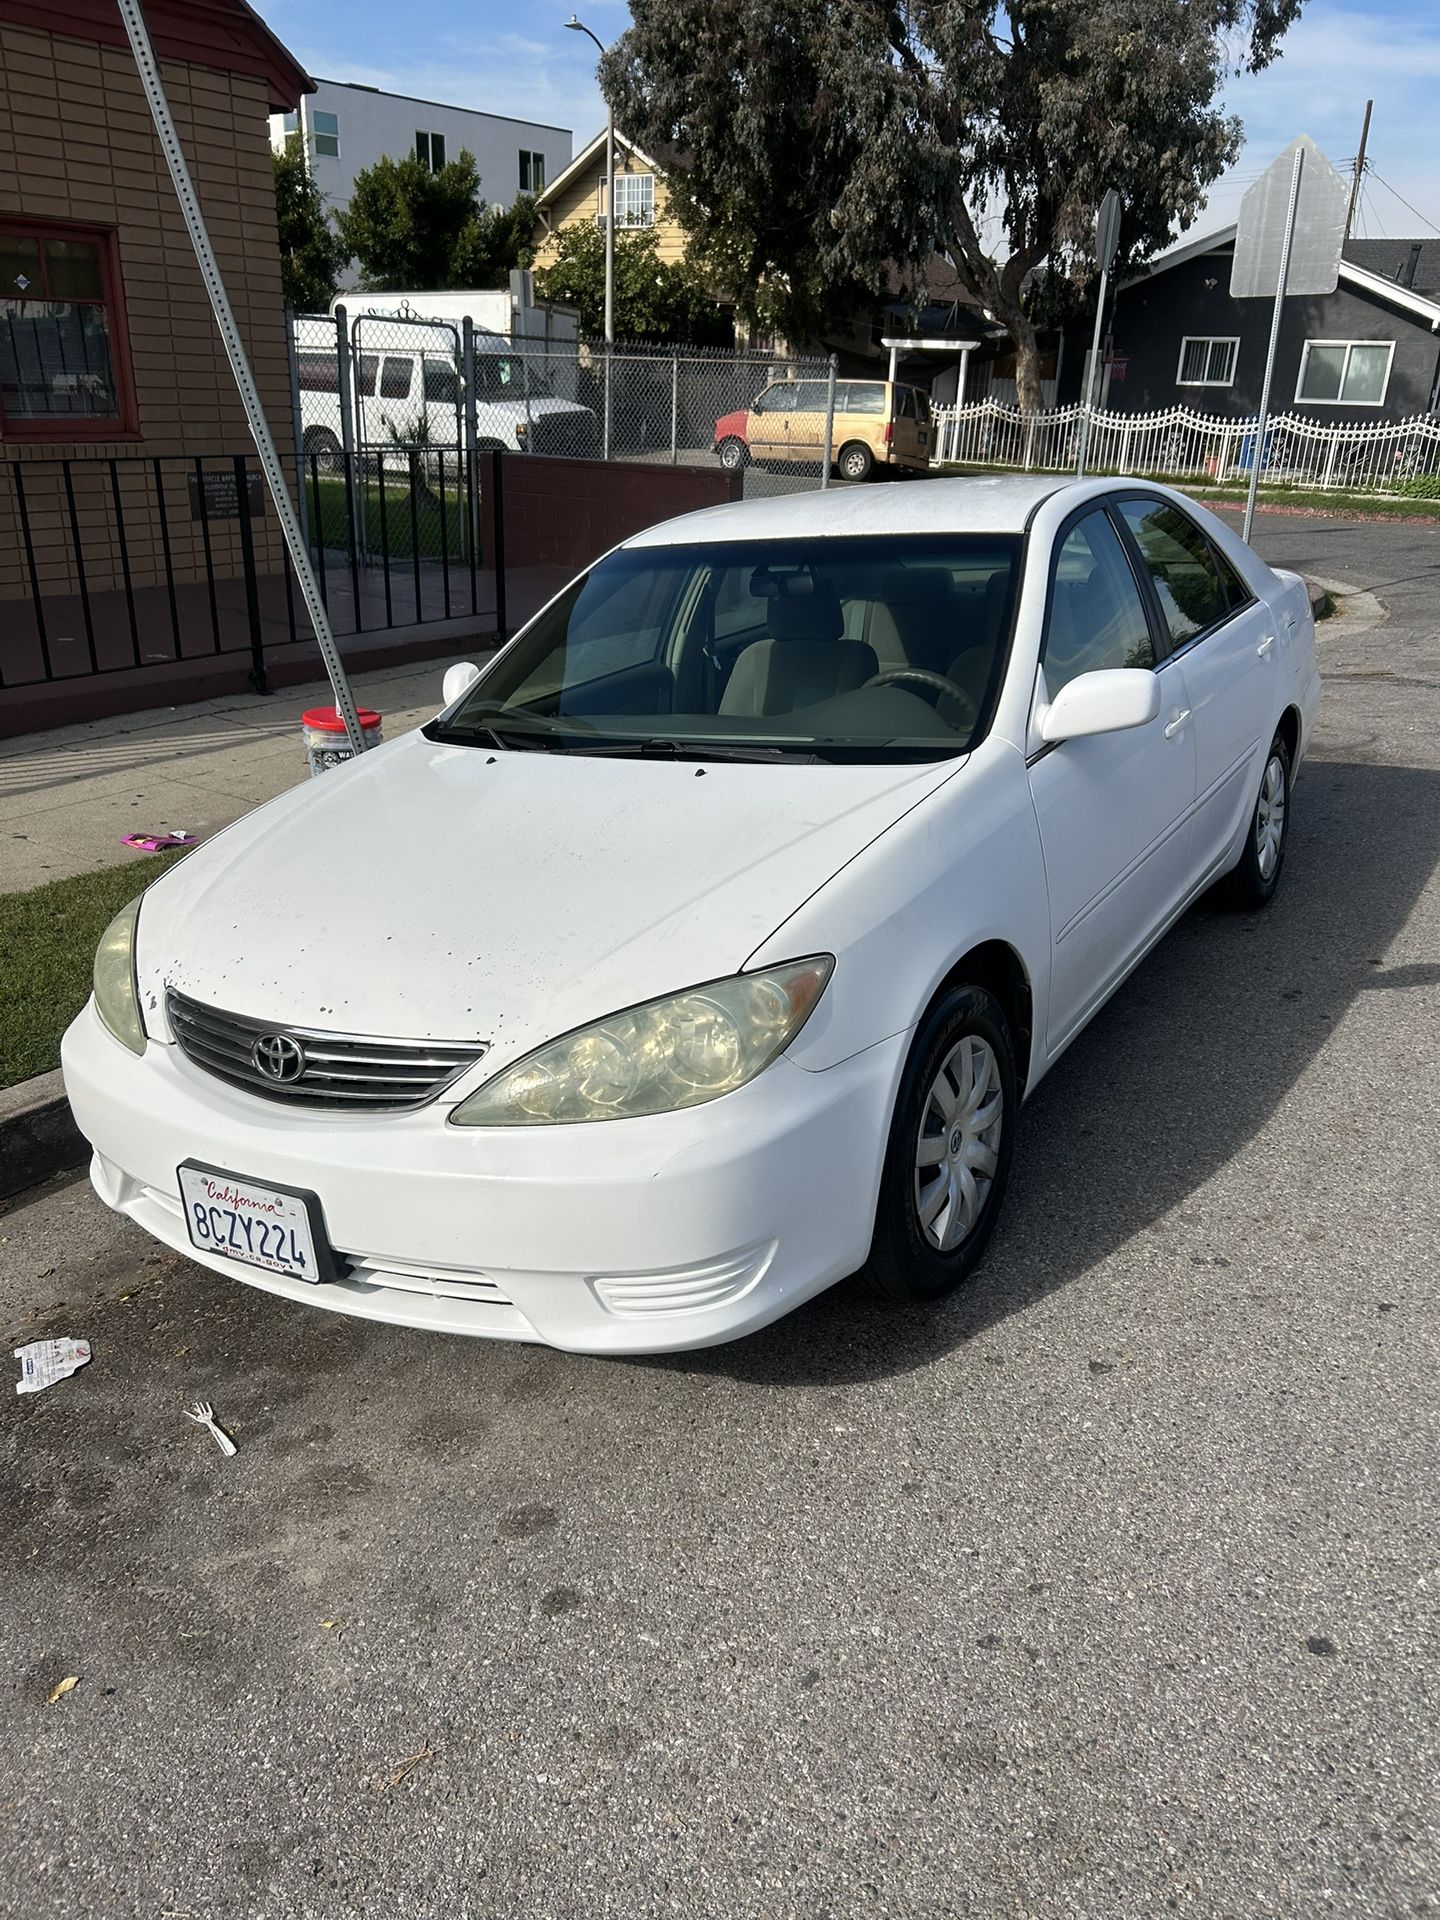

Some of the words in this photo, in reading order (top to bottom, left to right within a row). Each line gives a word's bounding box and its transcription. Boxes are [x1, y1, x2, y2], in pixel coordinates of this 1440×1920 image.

[207, 1181, 285, 1217] California
[193, 1203, 305, 1268] 8CZY224
[223, 1246, 286, 1269] dmv.ca.gov
